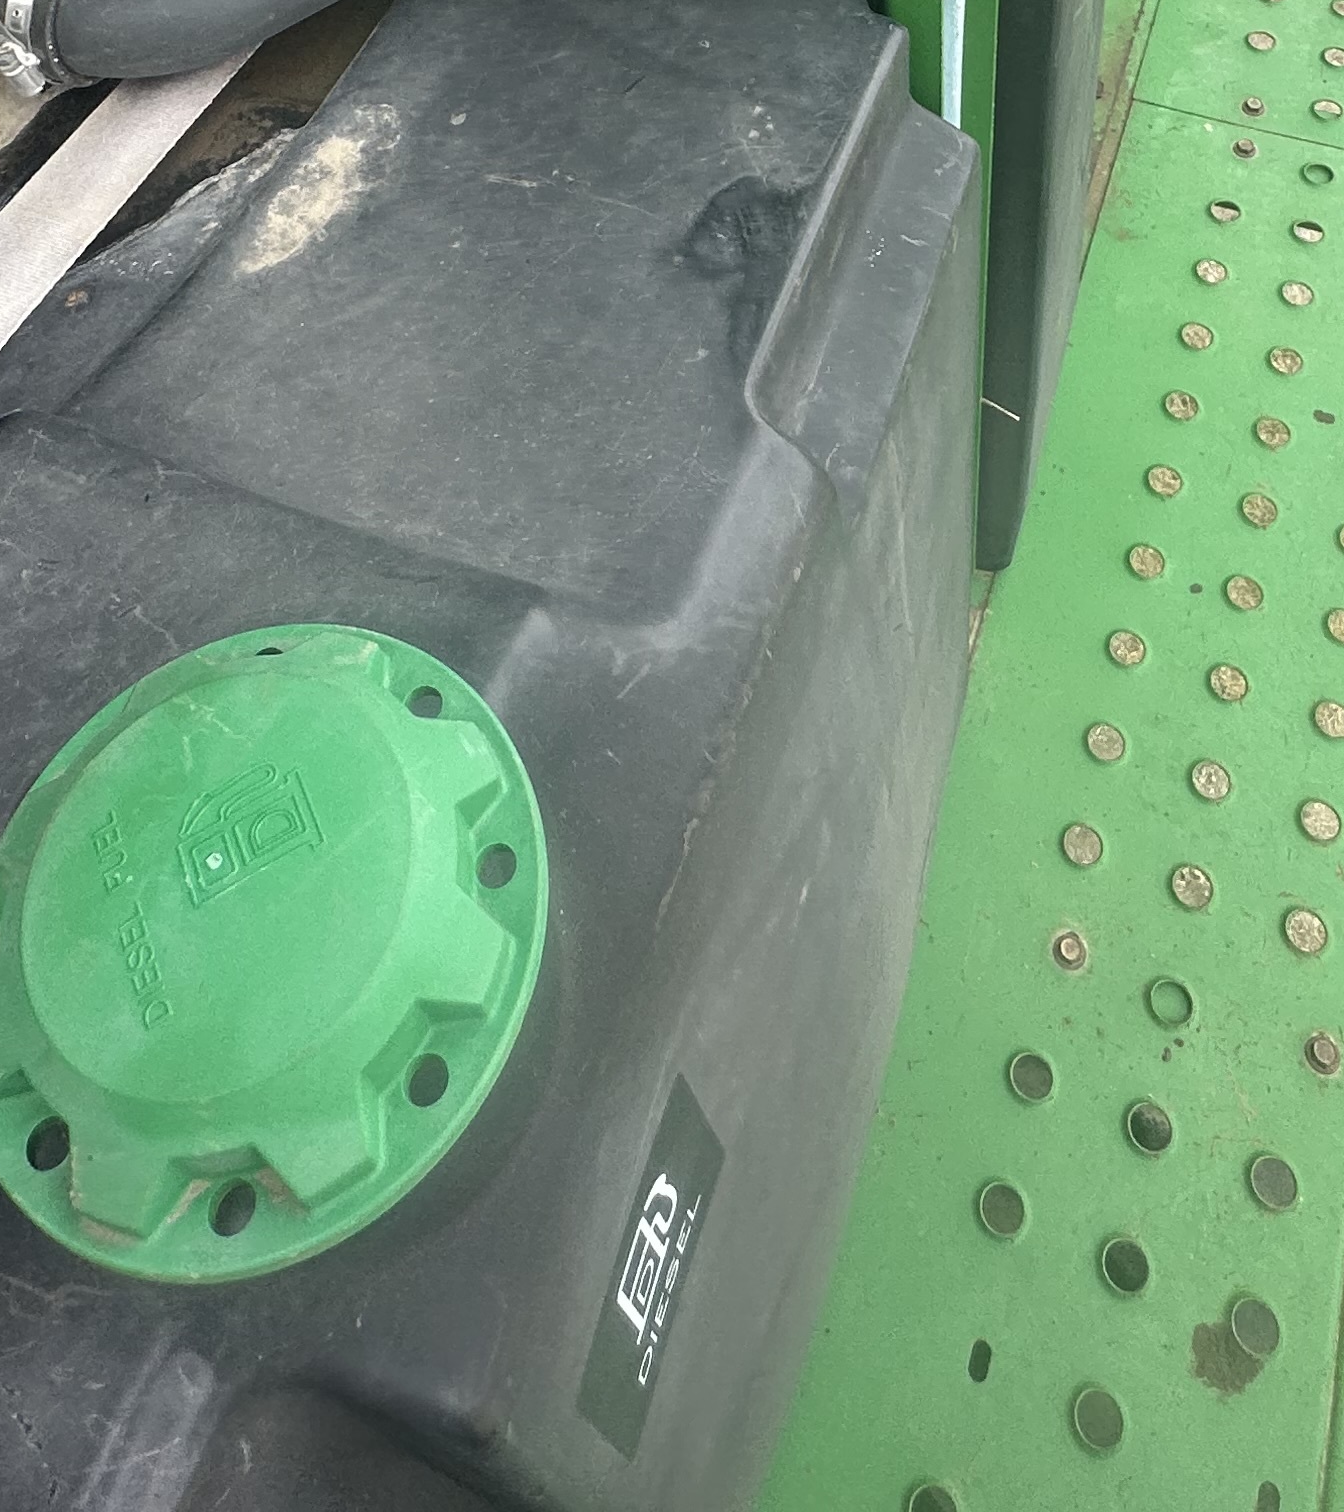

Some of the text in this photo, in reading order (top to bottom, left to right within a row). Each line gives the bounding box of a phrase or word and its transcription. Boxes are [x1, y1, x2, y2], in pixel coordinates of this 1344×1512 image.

[91, 808, 174, 1032] DIESEL FUEL
[638, 1195, 702, 1386] DIESEL
